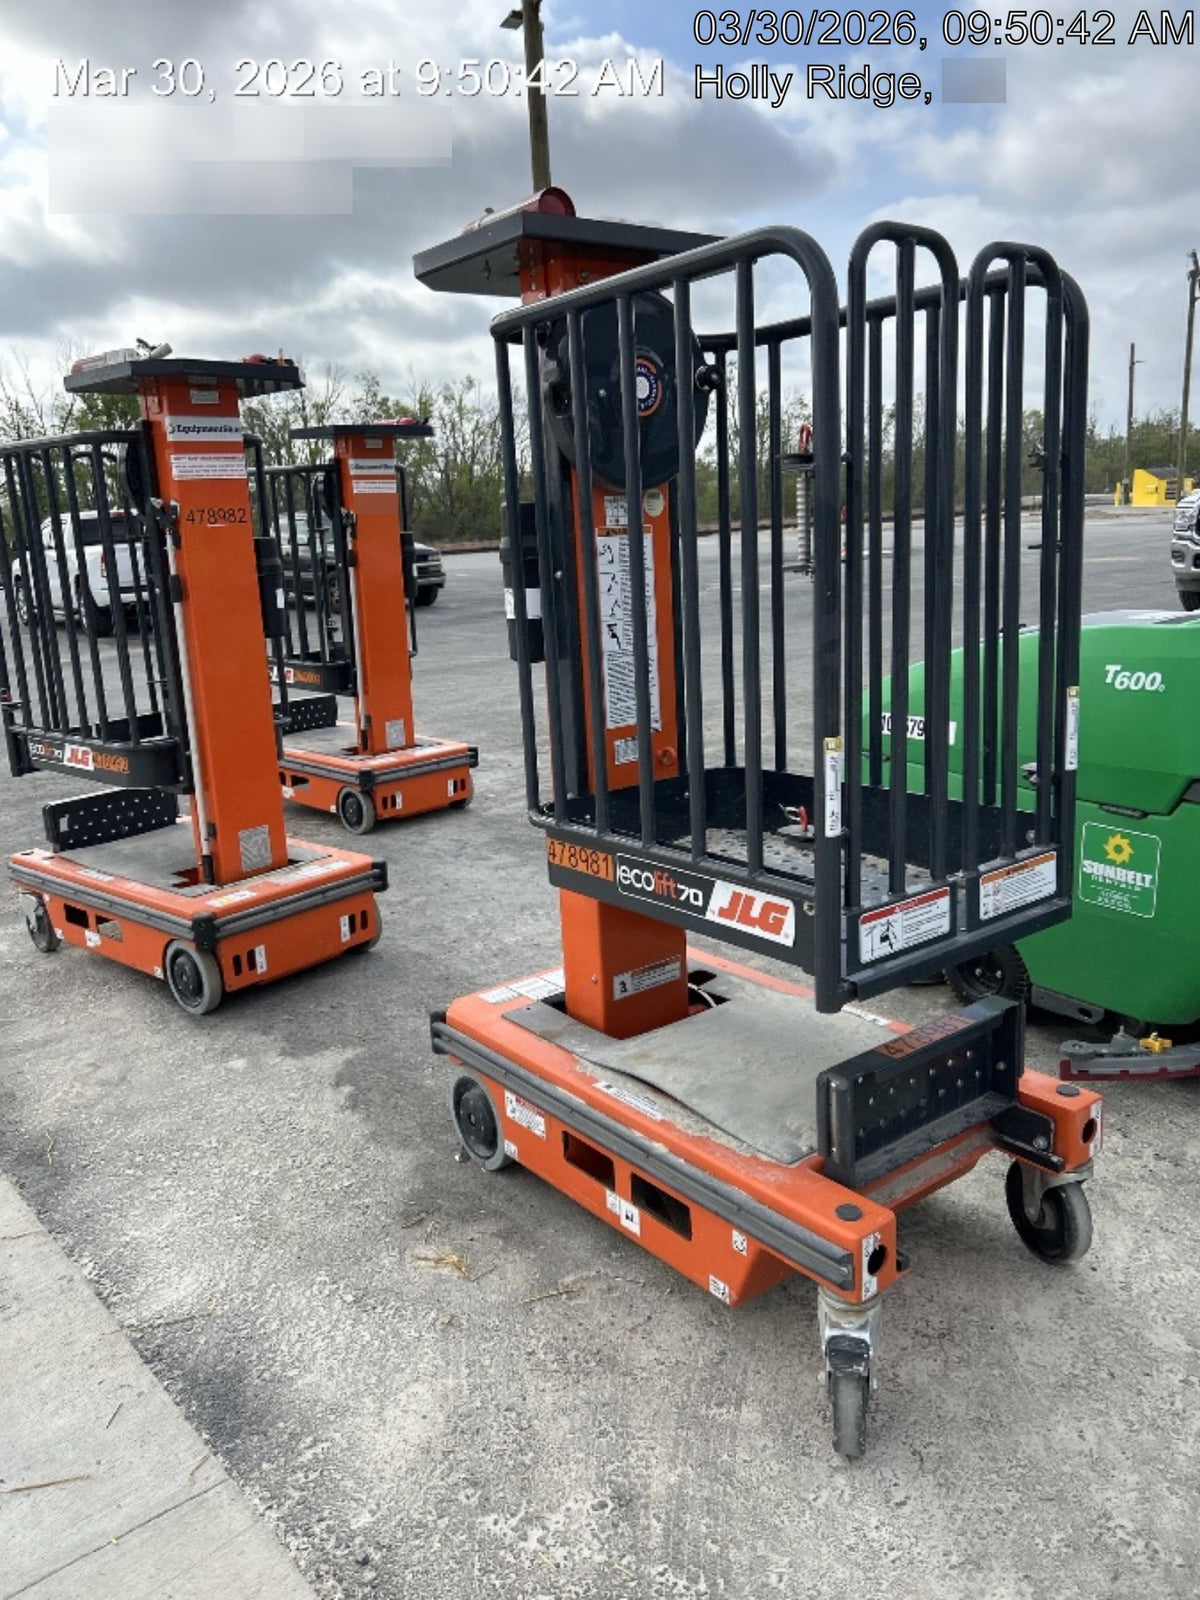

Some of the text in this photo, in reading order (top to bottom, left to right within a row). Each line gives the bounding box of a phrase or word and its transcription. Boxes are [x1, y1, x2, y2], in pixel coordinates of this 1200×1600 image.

[186, 508, 247, 525] 478982
[547, 840, 611, 878] 478981
[1082, 860, 1153, 888] SUNBELT
[718, 890, 790, 936] JLG
